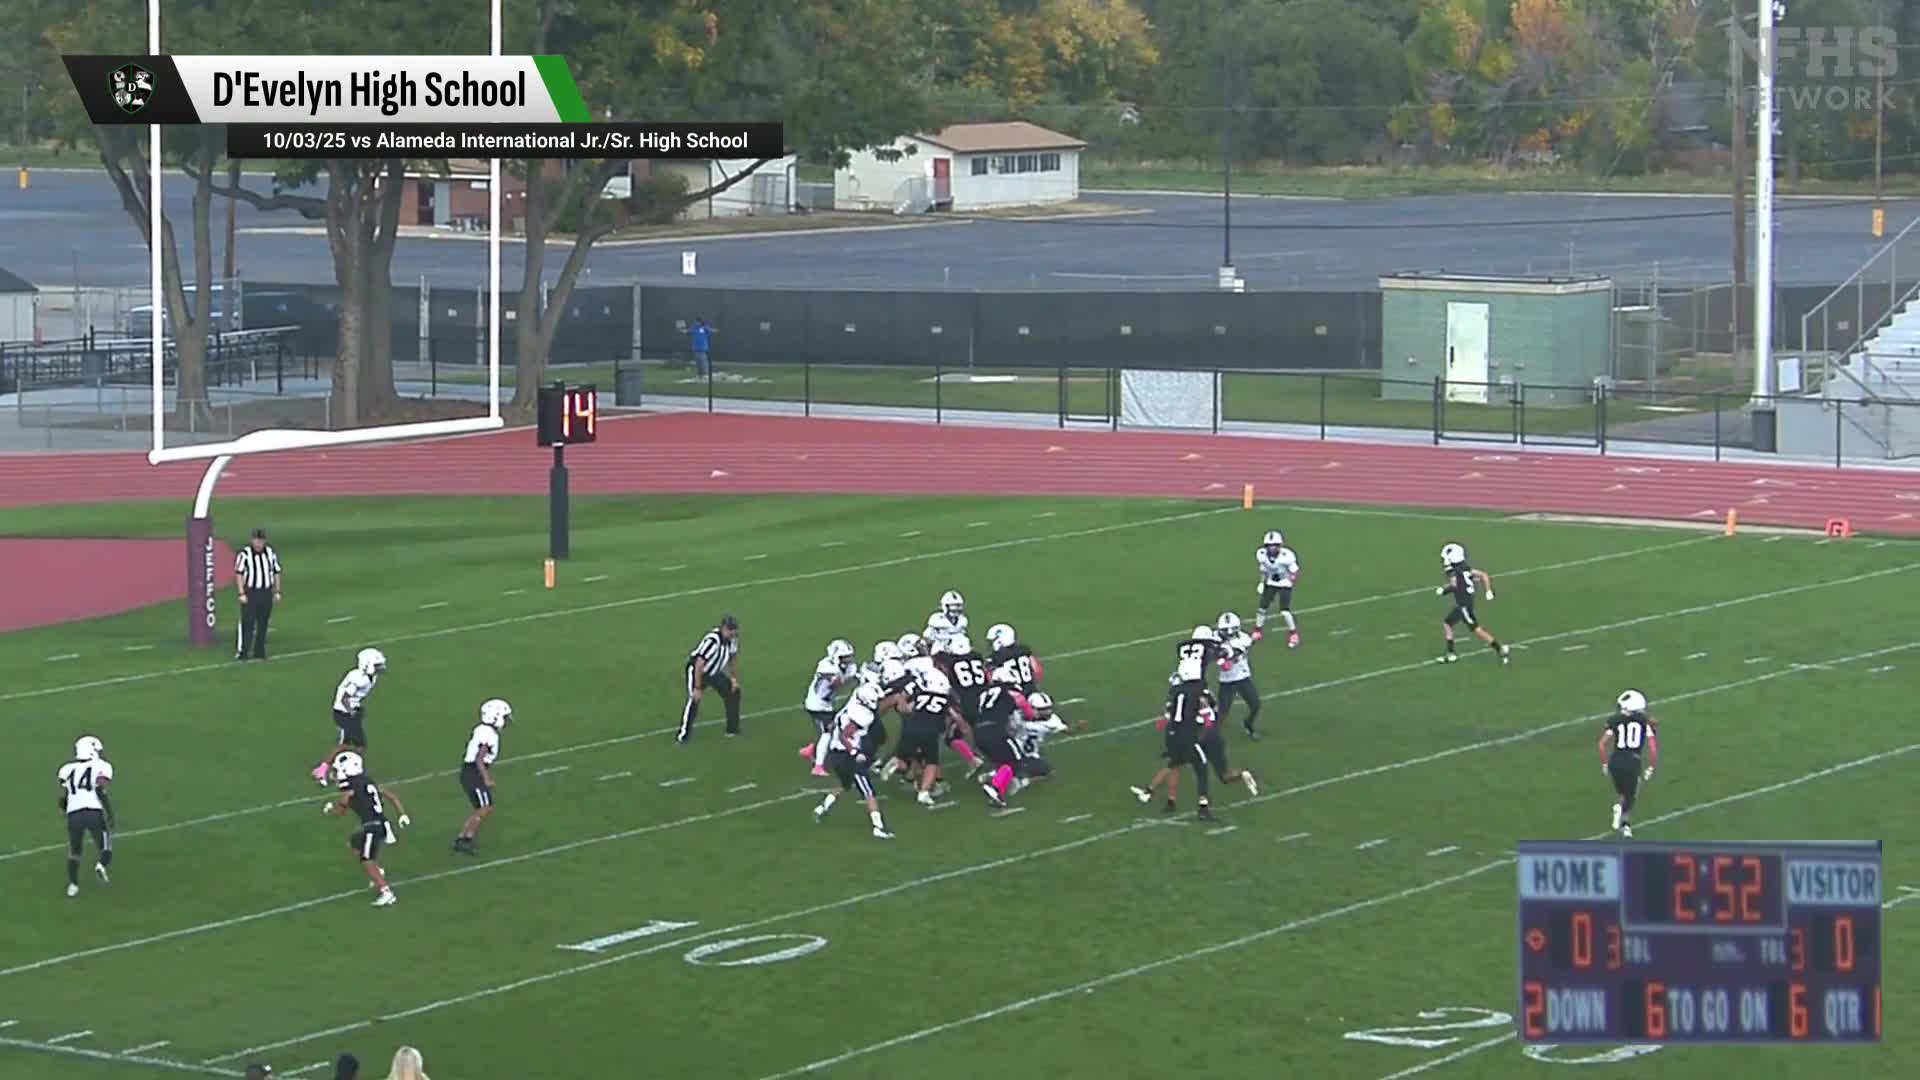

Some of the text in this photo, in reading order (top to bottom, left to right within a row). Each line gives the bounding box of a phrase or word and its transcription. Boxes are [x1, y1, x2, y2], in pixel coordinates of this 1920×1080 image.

[563, 392, 594, 437] 14
[206, 536, 215, 627] JEFFCO
[1463, 571, 1474, 594] 5
[953, 660, 985, 687] 65
[915, 695, 947, 713] 75
[979, 686, 1001, 712] 17
[1174, 693, 1184, 722] 1
[1617, 721, 1641, 749] 10
[67, 766, 92, 795] 14
[367, 784, 382, 813] 3
